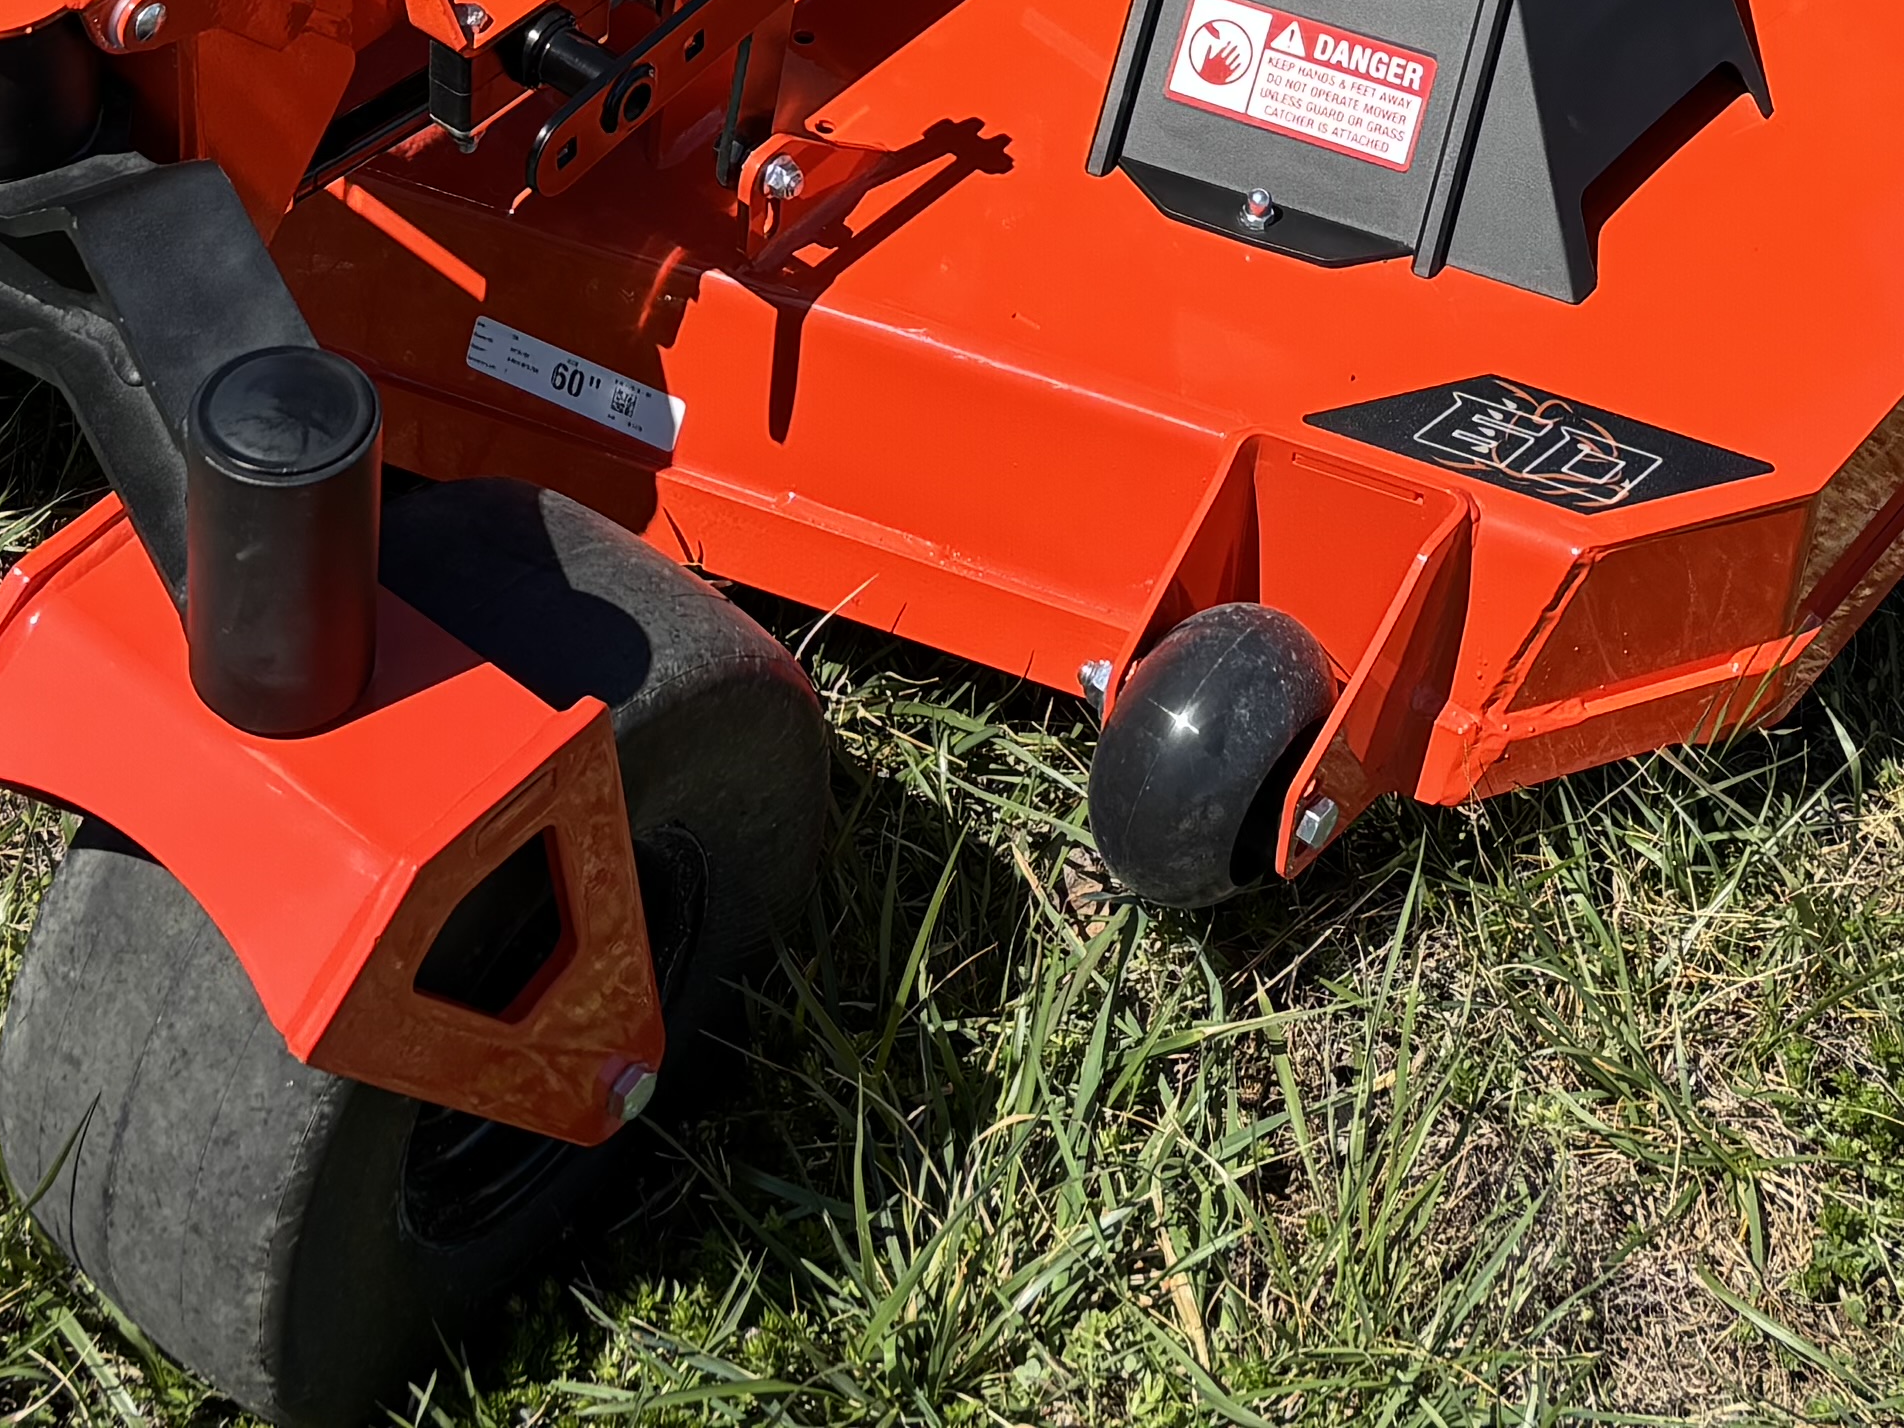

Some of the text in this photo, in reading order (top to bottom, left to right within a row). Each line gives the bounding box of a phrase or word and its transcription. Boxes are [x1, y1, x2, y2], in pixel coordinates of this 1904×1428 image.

[1267, 55, 1413, 111] KEEP HANDS & FEET AWAY
[1313, 32, 1424, 91] DANGER
[1259, 87, 1406, 142] UNLESS GUARD OR GRASS
[1266, 72, 1408, 126] DO NOT OPERATE MOWER
[1263, 104, 1390, 154] CATCHER IS ATTACHED
[550, 361, 602, 398] 60"
